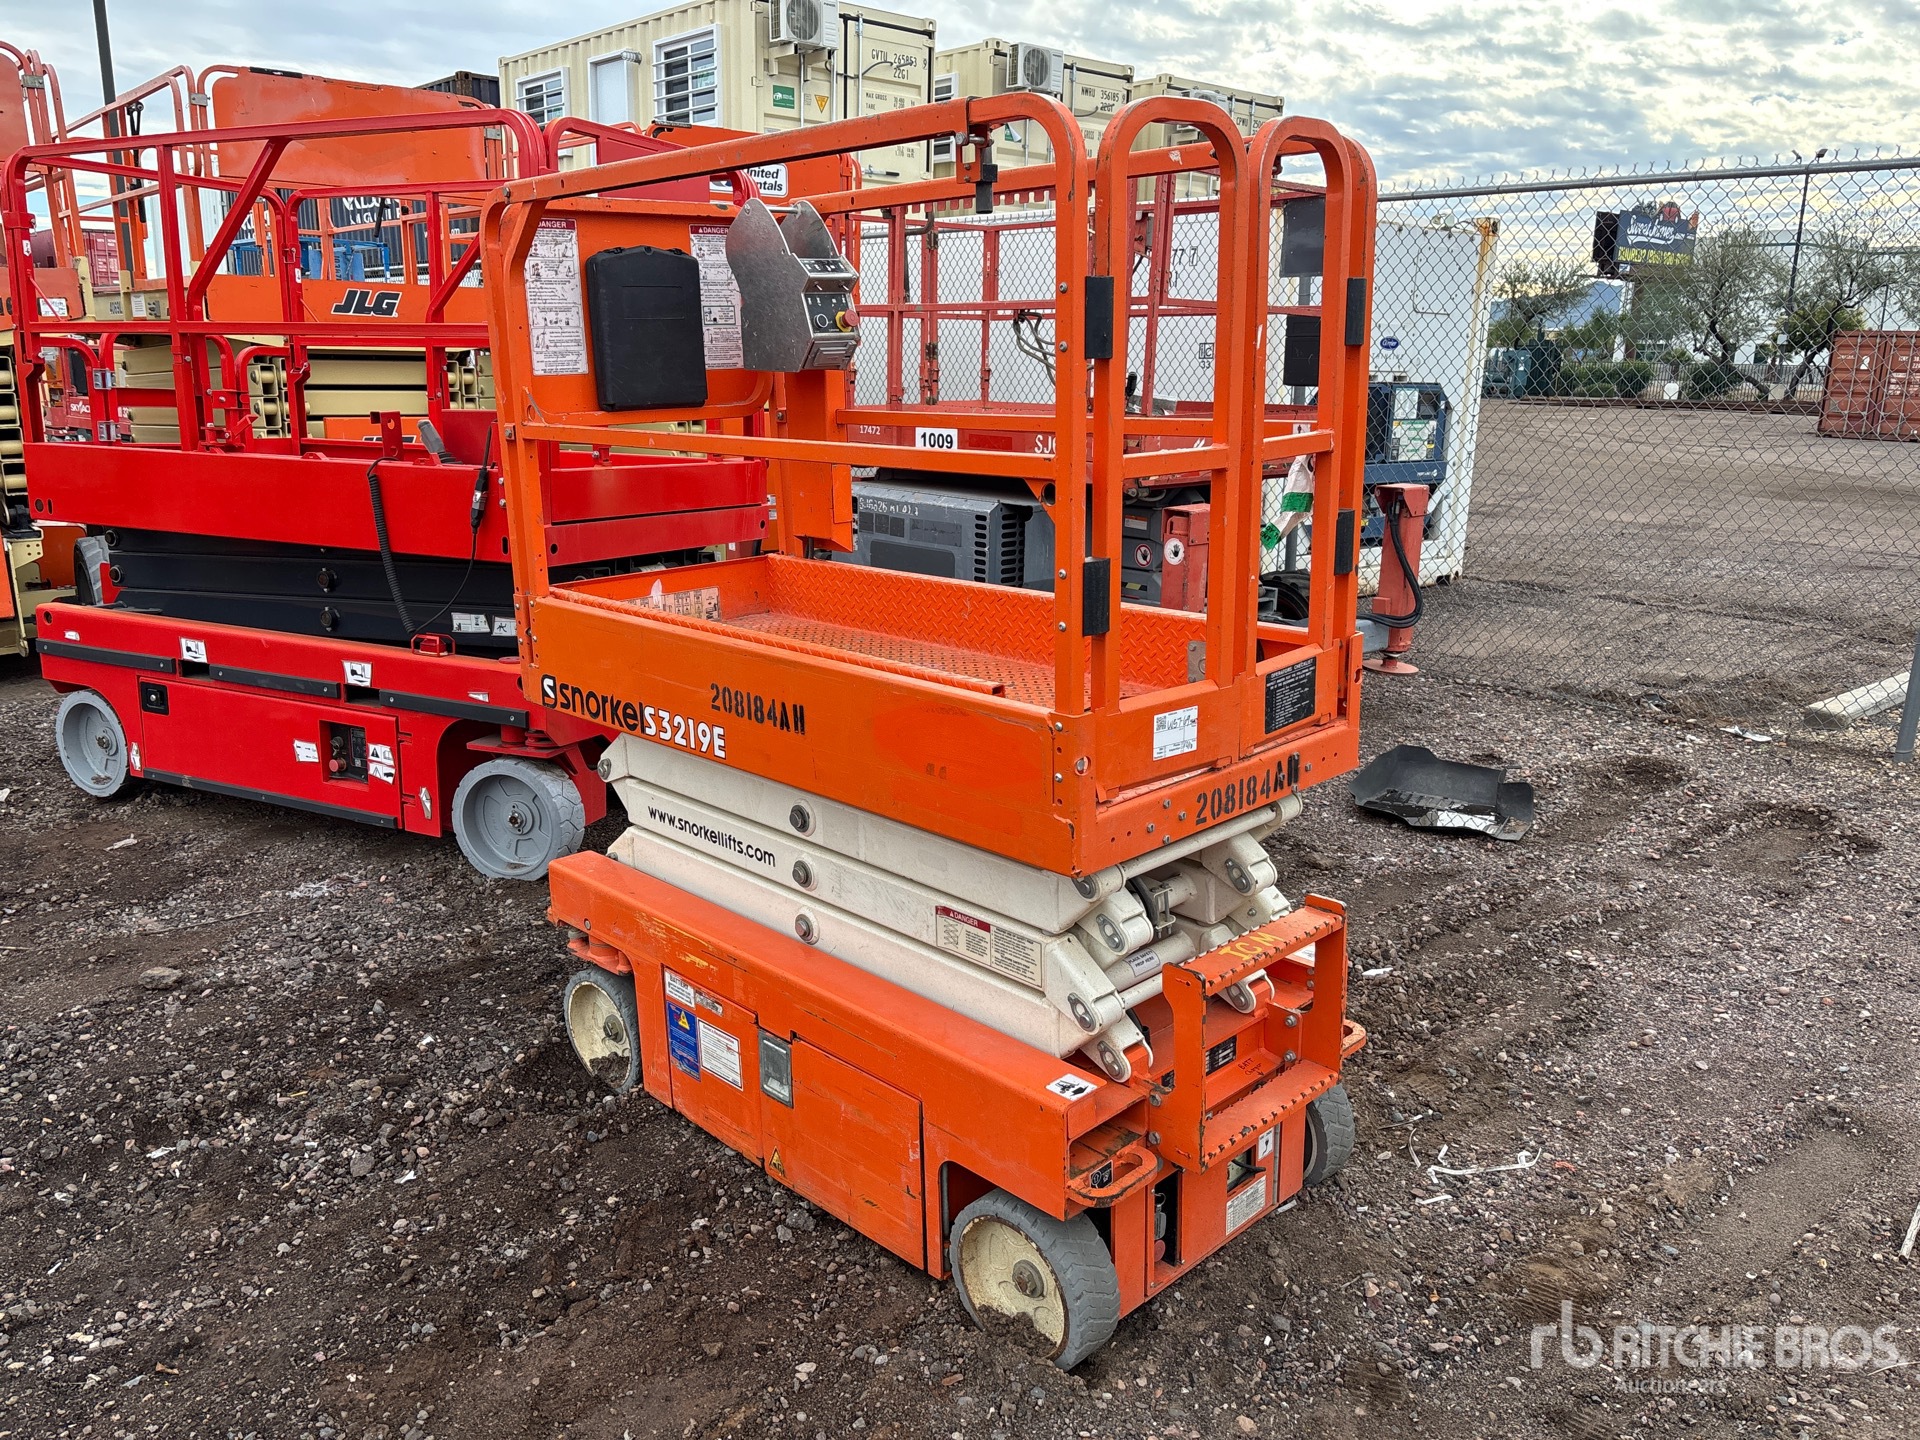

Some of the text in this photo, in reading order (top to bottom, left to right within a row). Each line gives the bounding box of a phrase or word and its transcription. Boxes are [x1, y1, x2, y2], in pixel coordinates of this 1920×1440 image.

[872, 48, 888, 62] GVTU
[894, 68, 909, 80] 22G1
[1081, 86, 1096, 98] NWRU
[1100, 90, 1120, 102] 356185
[332, 289, 402, 317] JLG
[1200, 360, 1211, 369] 33
[860, 426, 880, 434] 17472
[920, 432, 954, 449] 1009
[1034, 434, 1056, 454] SJ
[560, 682, 645, 734] snorkel
[644, 706, 727, 760] S3219E
[648, 806, 776, 868] www.snorkellifts.com
[955, 912, 978, 927] DANGER
